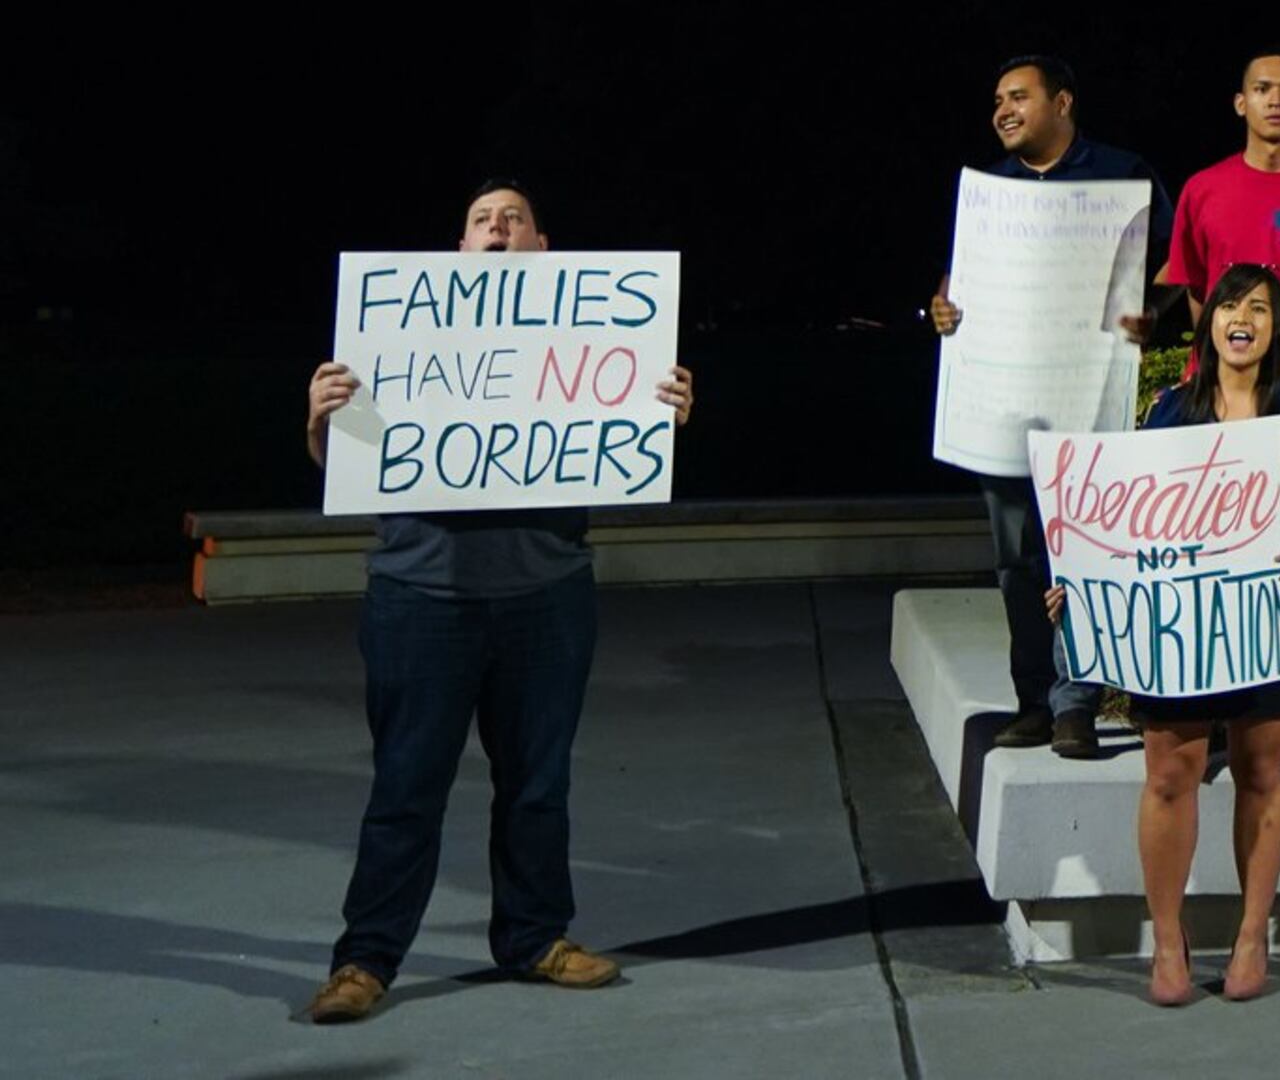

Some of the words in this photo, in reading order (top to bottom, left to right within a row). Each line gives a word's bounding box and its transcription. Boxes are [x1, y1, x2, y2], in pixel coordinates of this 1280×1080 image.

[358, 268, 660, 334] FAMILIES
[371, 348, 518, 403] HAVE
[536, 344, 638, 407] NO
[378, 419, 670, 495] BORDERS
[1137, 544, 1205, 573] NOT
